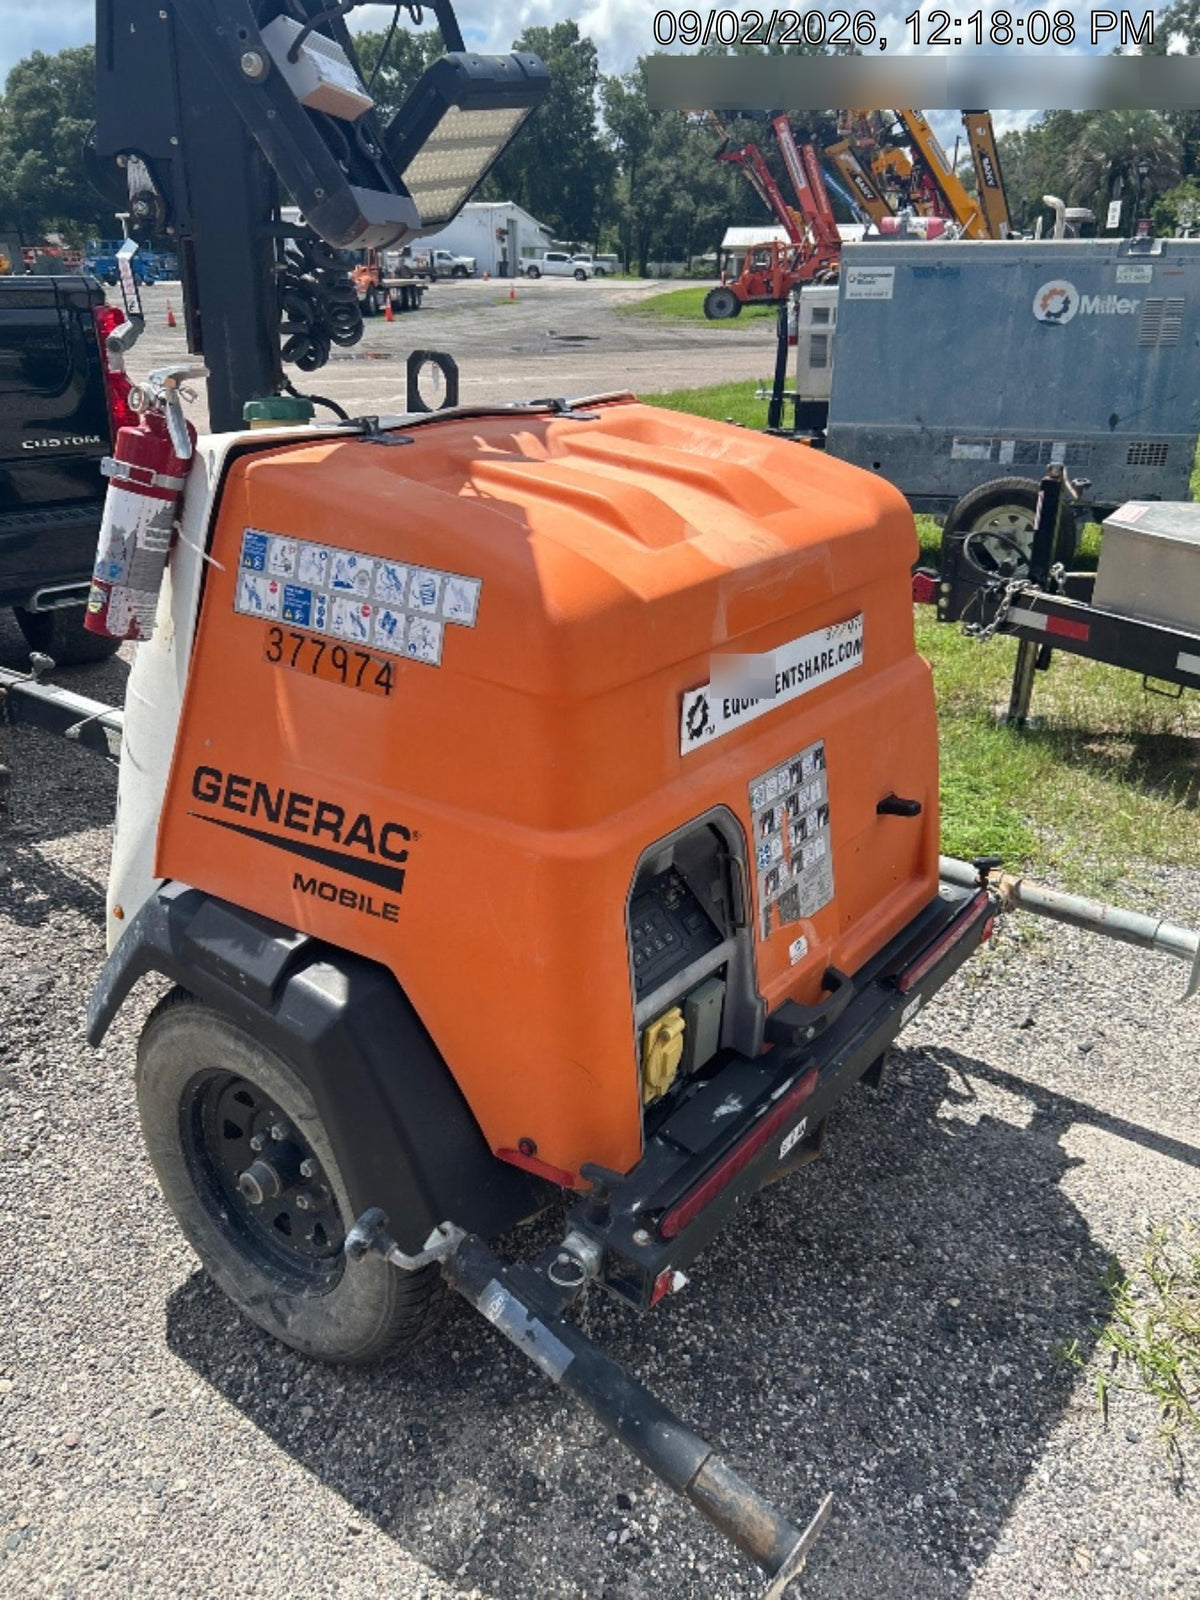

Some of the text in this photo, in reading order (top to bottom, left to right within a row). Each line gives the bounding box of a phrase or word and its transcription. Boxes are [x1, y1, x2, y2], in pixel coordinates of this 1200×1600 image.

[1078, 294, 1141, 315] Miller
[21, 435, 101, 449] CUSTOM
[266, 627, 393, 696] 377974
[292, 873, 401, 924] MOBILE
